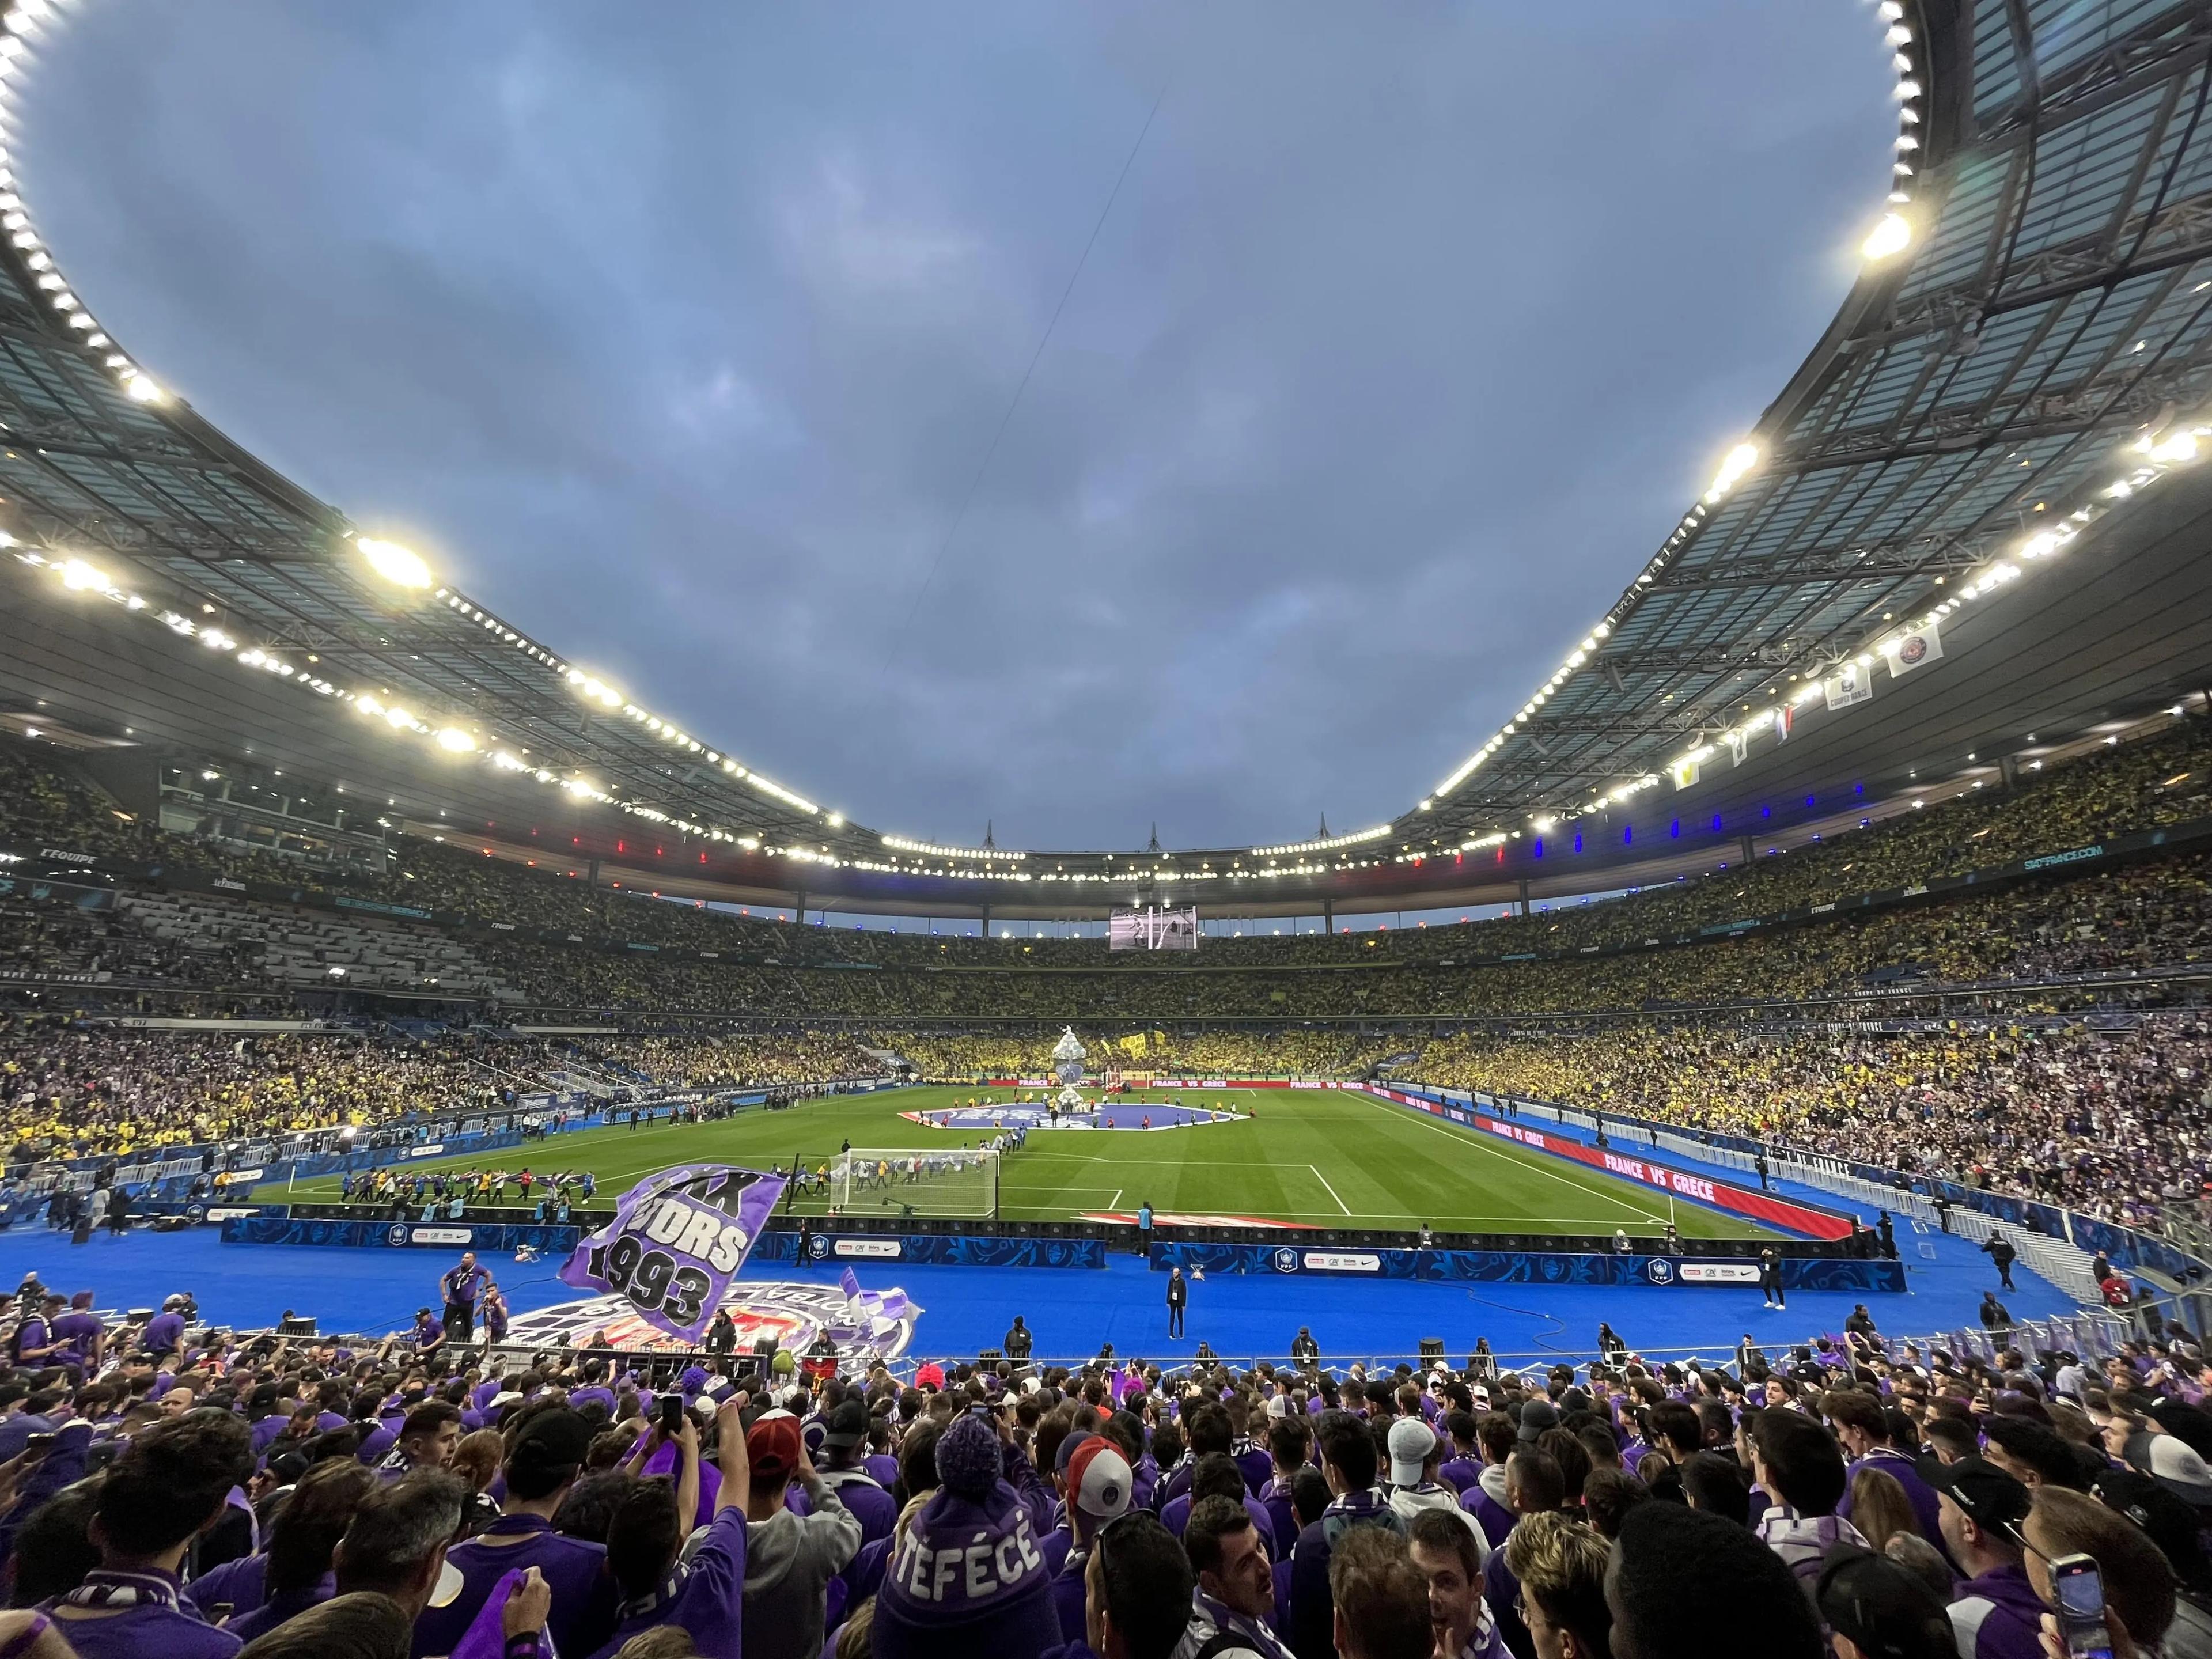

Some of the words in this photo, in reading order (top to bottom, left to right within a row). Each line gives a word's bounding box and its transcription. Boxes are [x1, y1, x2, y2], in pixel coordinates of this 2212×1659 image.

[1604, 1154, 1644, 1180] FRANCE
[1649, 1166, 1666, 1187] VS
[1672, 1173, 1715, 1202] GRECE
[586, 1234, 712, 1328] 1993
